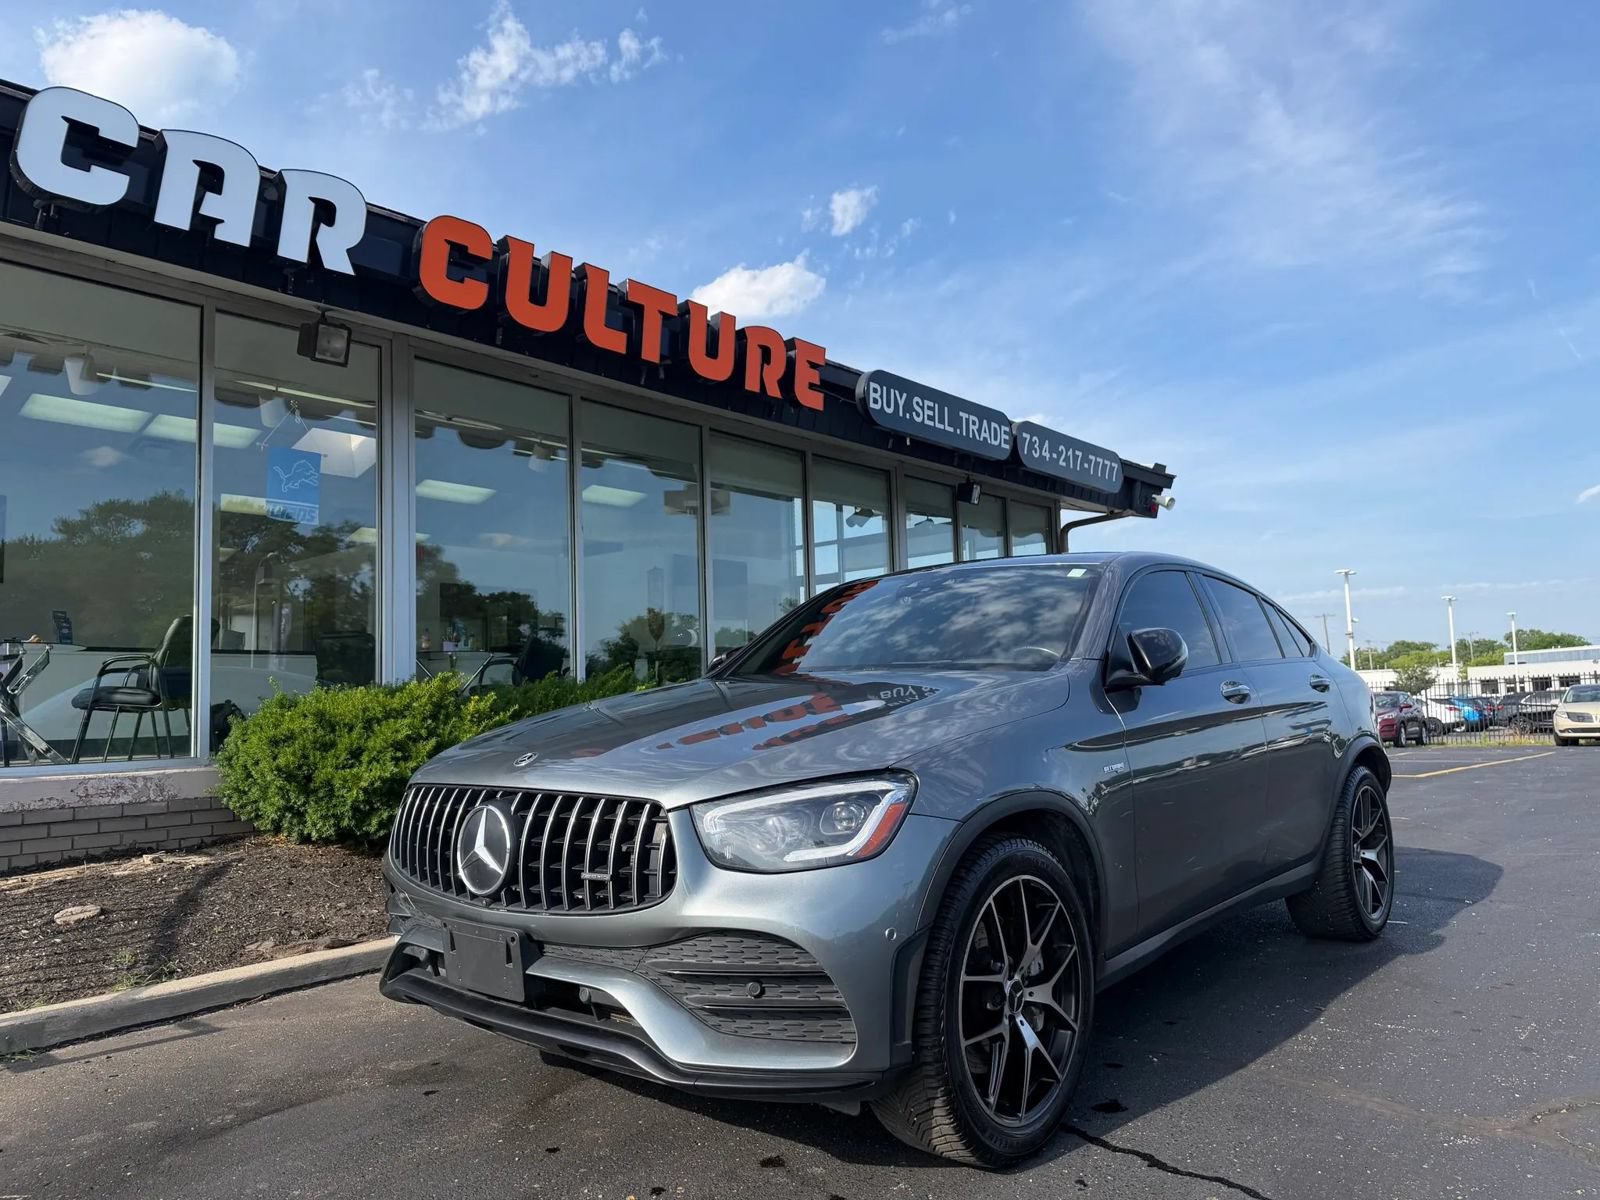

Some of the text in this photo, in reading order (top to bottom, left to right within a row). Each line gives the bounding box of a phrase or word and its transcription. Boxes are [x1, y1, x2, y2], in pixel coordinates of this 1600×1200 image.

[13, 86, 826, 411] CAR CULTURE
[1022, 432, 1118, 482] 734-217-7777
